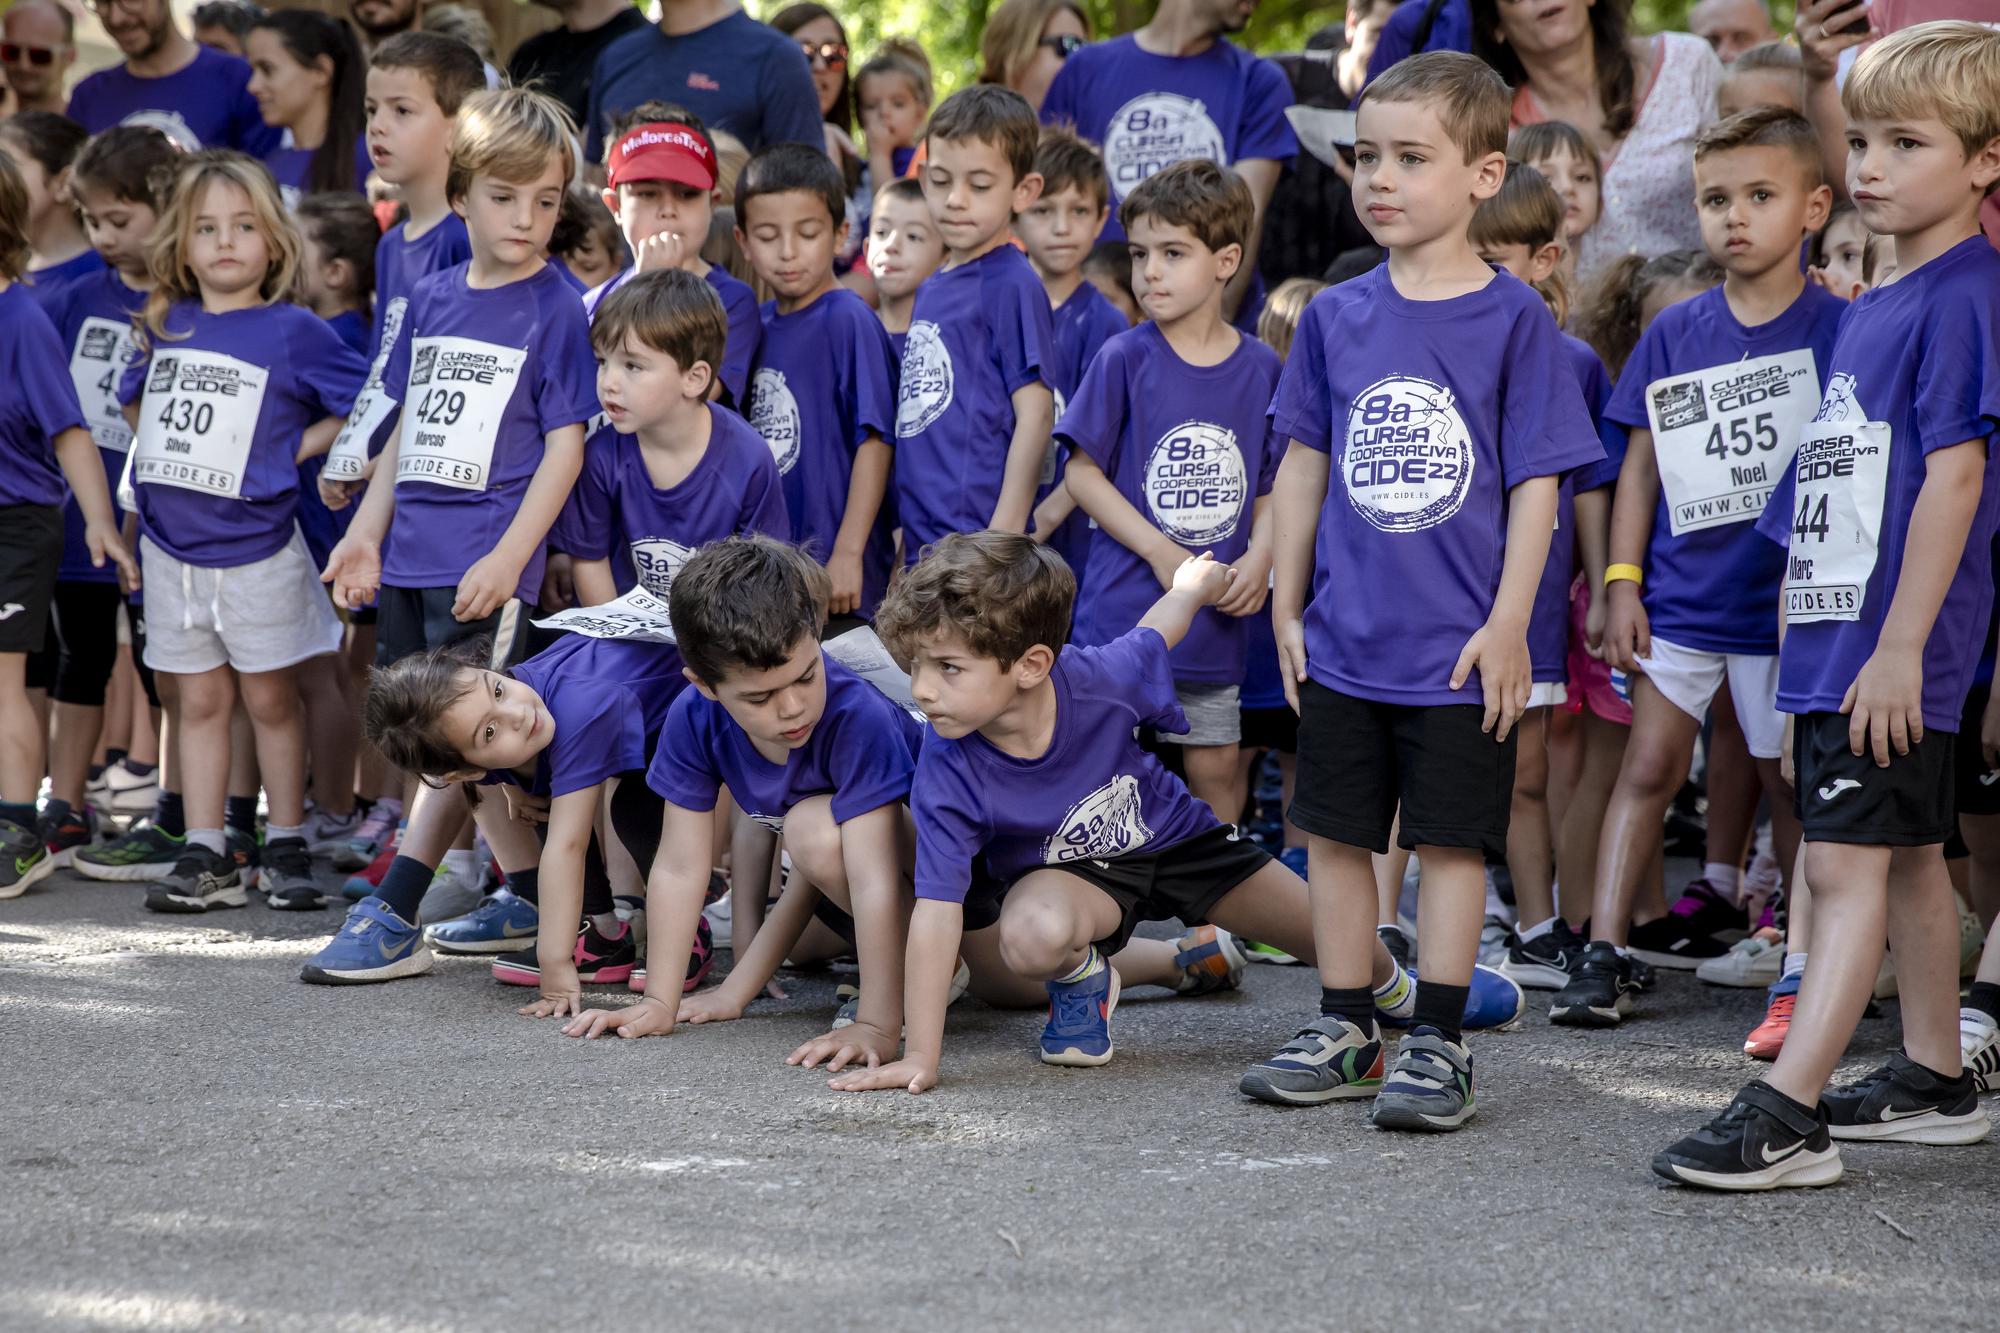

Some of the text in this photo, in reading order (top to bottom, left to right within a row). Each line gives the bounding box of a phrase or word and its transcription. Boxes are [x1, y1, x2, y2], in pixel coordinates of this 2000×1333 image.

[1127, 110, 1167, 131] 8a
[441, 352, 498, 364] CURSA
[182, 363, 240, 377] CURSA
[437, 368, 495, 385] CIDE
[1712, 365, 1783, 392] CURSA
[181, 380, 238, 397] CIDE
[1709, 368, 1808, 400] COOPERATIVA
[416, 388, 466, 426] 429
[1717, 380, 1791, 412] CIDE
[159, 397, 213, 435] 430
[1362, 394, 1411, 425] 8a
[415, 431, 446, 448] Marcos
[1353, 426, 1430, 447] CURSA
[1705, 412, 1778, 460] 455
[1800, 435, 1854, 456] CURSA
[1168, 437, 1206, 461] 8a
[1350, 444, 1457, 463] COOPERATIVA
[1157, 462, 1220, 478] CURSA
[1731, 462, 1767, 487] Noel
[1798, 458, 1854, 484] CIDE
[1152, 476, 1239, 490] COOPERATIVA
[1371, 492, 1430, 501] WWW.CIDE.ES
[1792, 494, 1829, 544] 44
[1789, 555, 1813, 581] Marc
